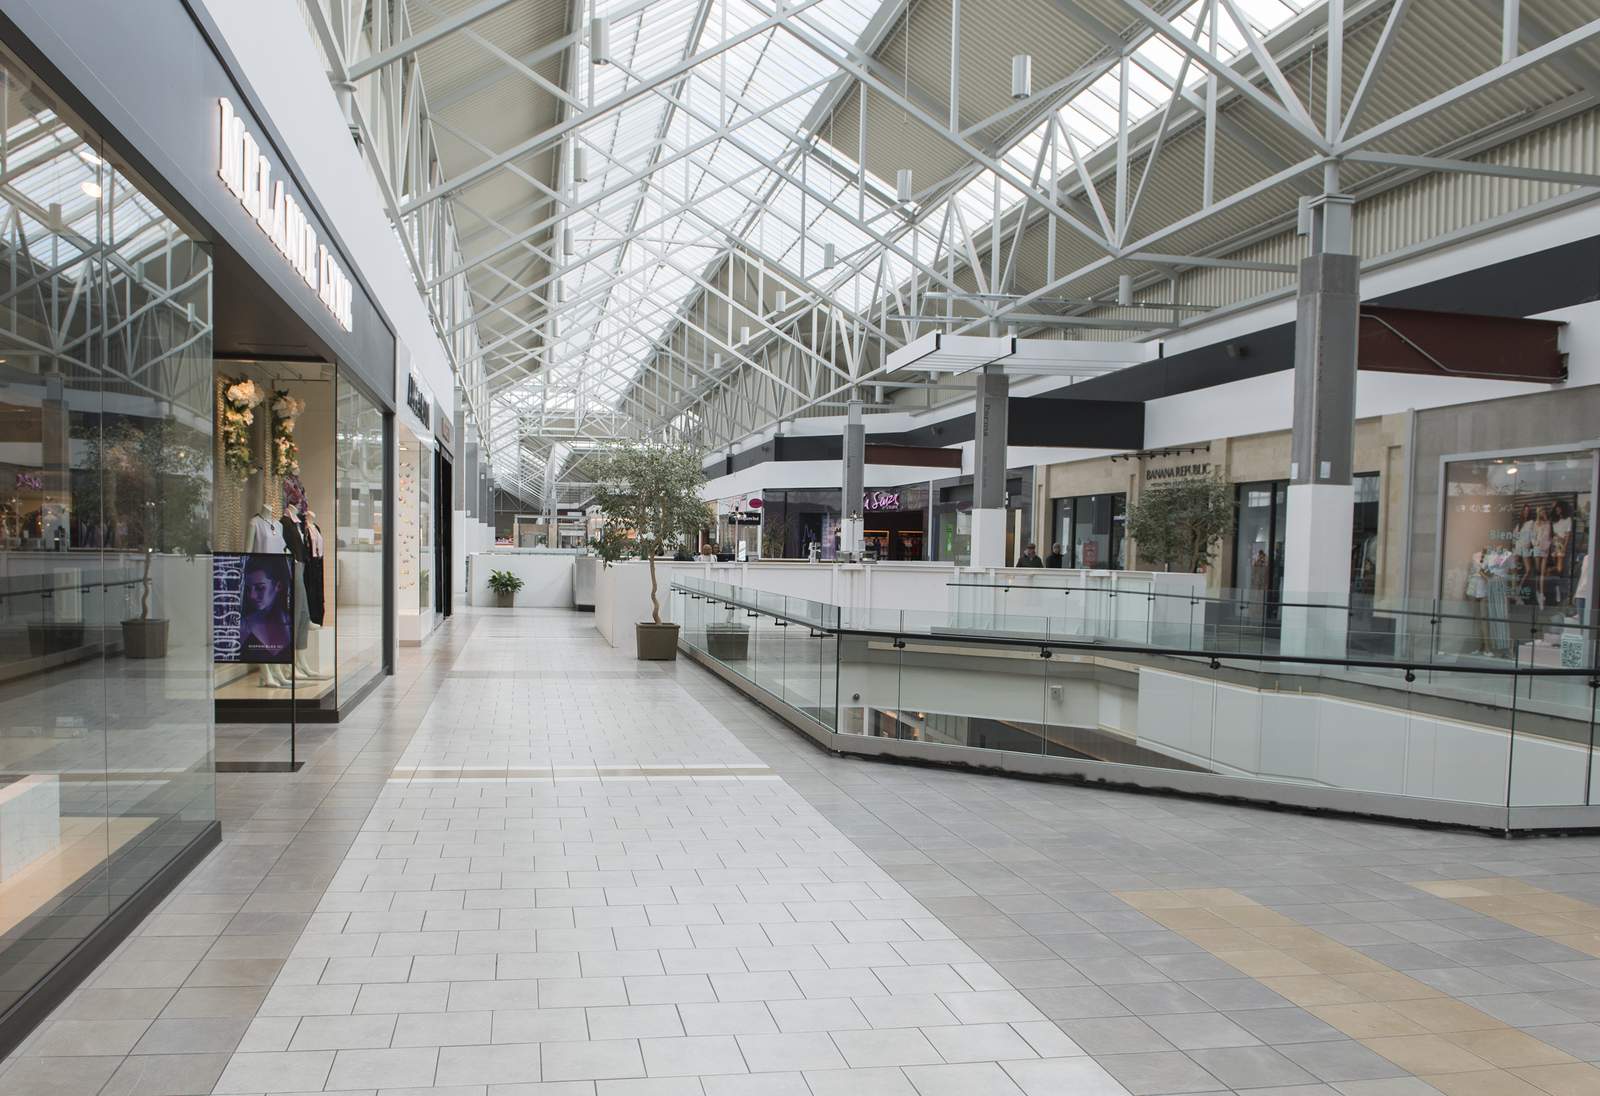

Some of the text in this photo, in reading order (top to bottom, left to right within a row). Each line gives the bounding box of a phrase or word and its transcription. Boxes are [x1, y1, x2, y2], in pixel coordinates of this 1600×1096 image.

[1146, 463, 1211, 480] BANANA REPUBLIC
[213, 588, 241, 605] DE
[213, 611, 241, 662] ROBES
